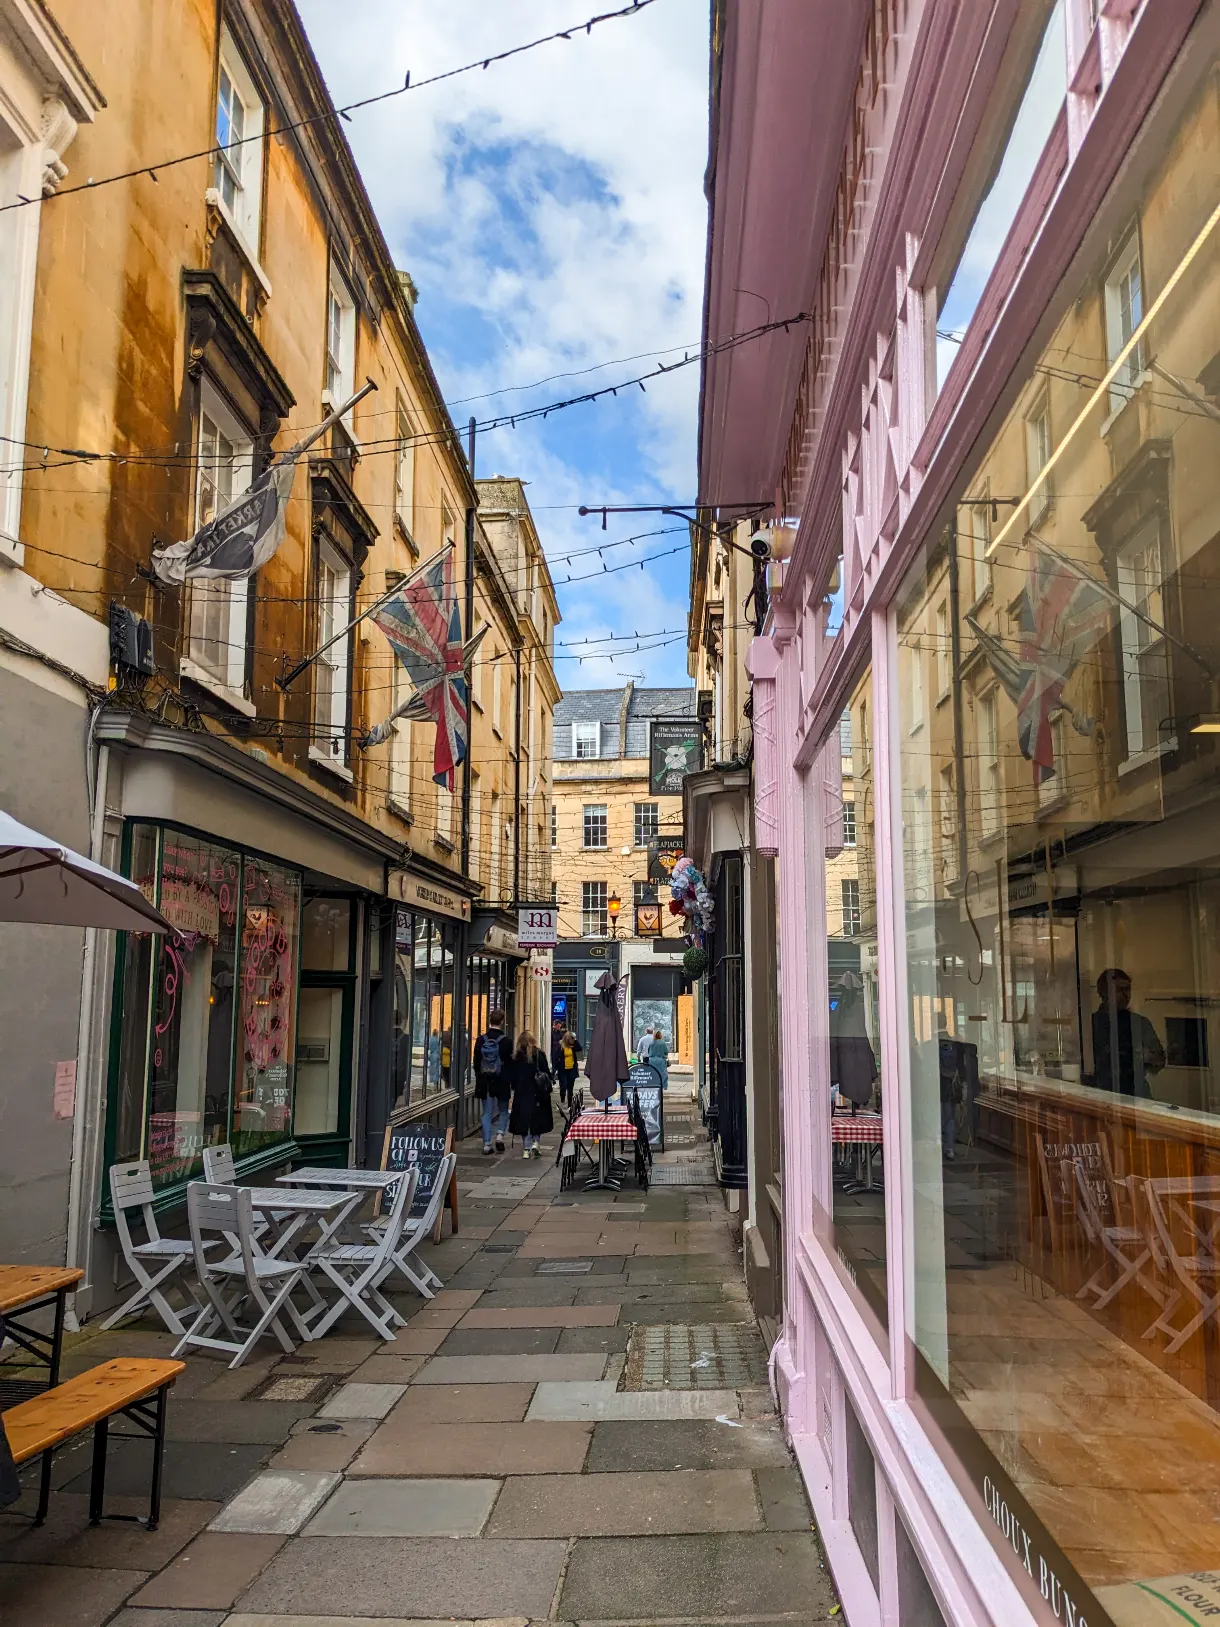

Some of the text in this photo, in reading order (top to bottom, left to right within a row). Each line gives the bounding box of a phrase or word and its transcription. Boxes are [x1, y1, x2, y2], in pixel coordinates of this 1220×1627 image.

[196, 914, 213, 934] LOVE
[391, 1136, 445, 1151] FOLLOW US
[983, 1475, 1033, 1578] CHOUX
[1170, 1585, 1220, 1617] FLOUR
